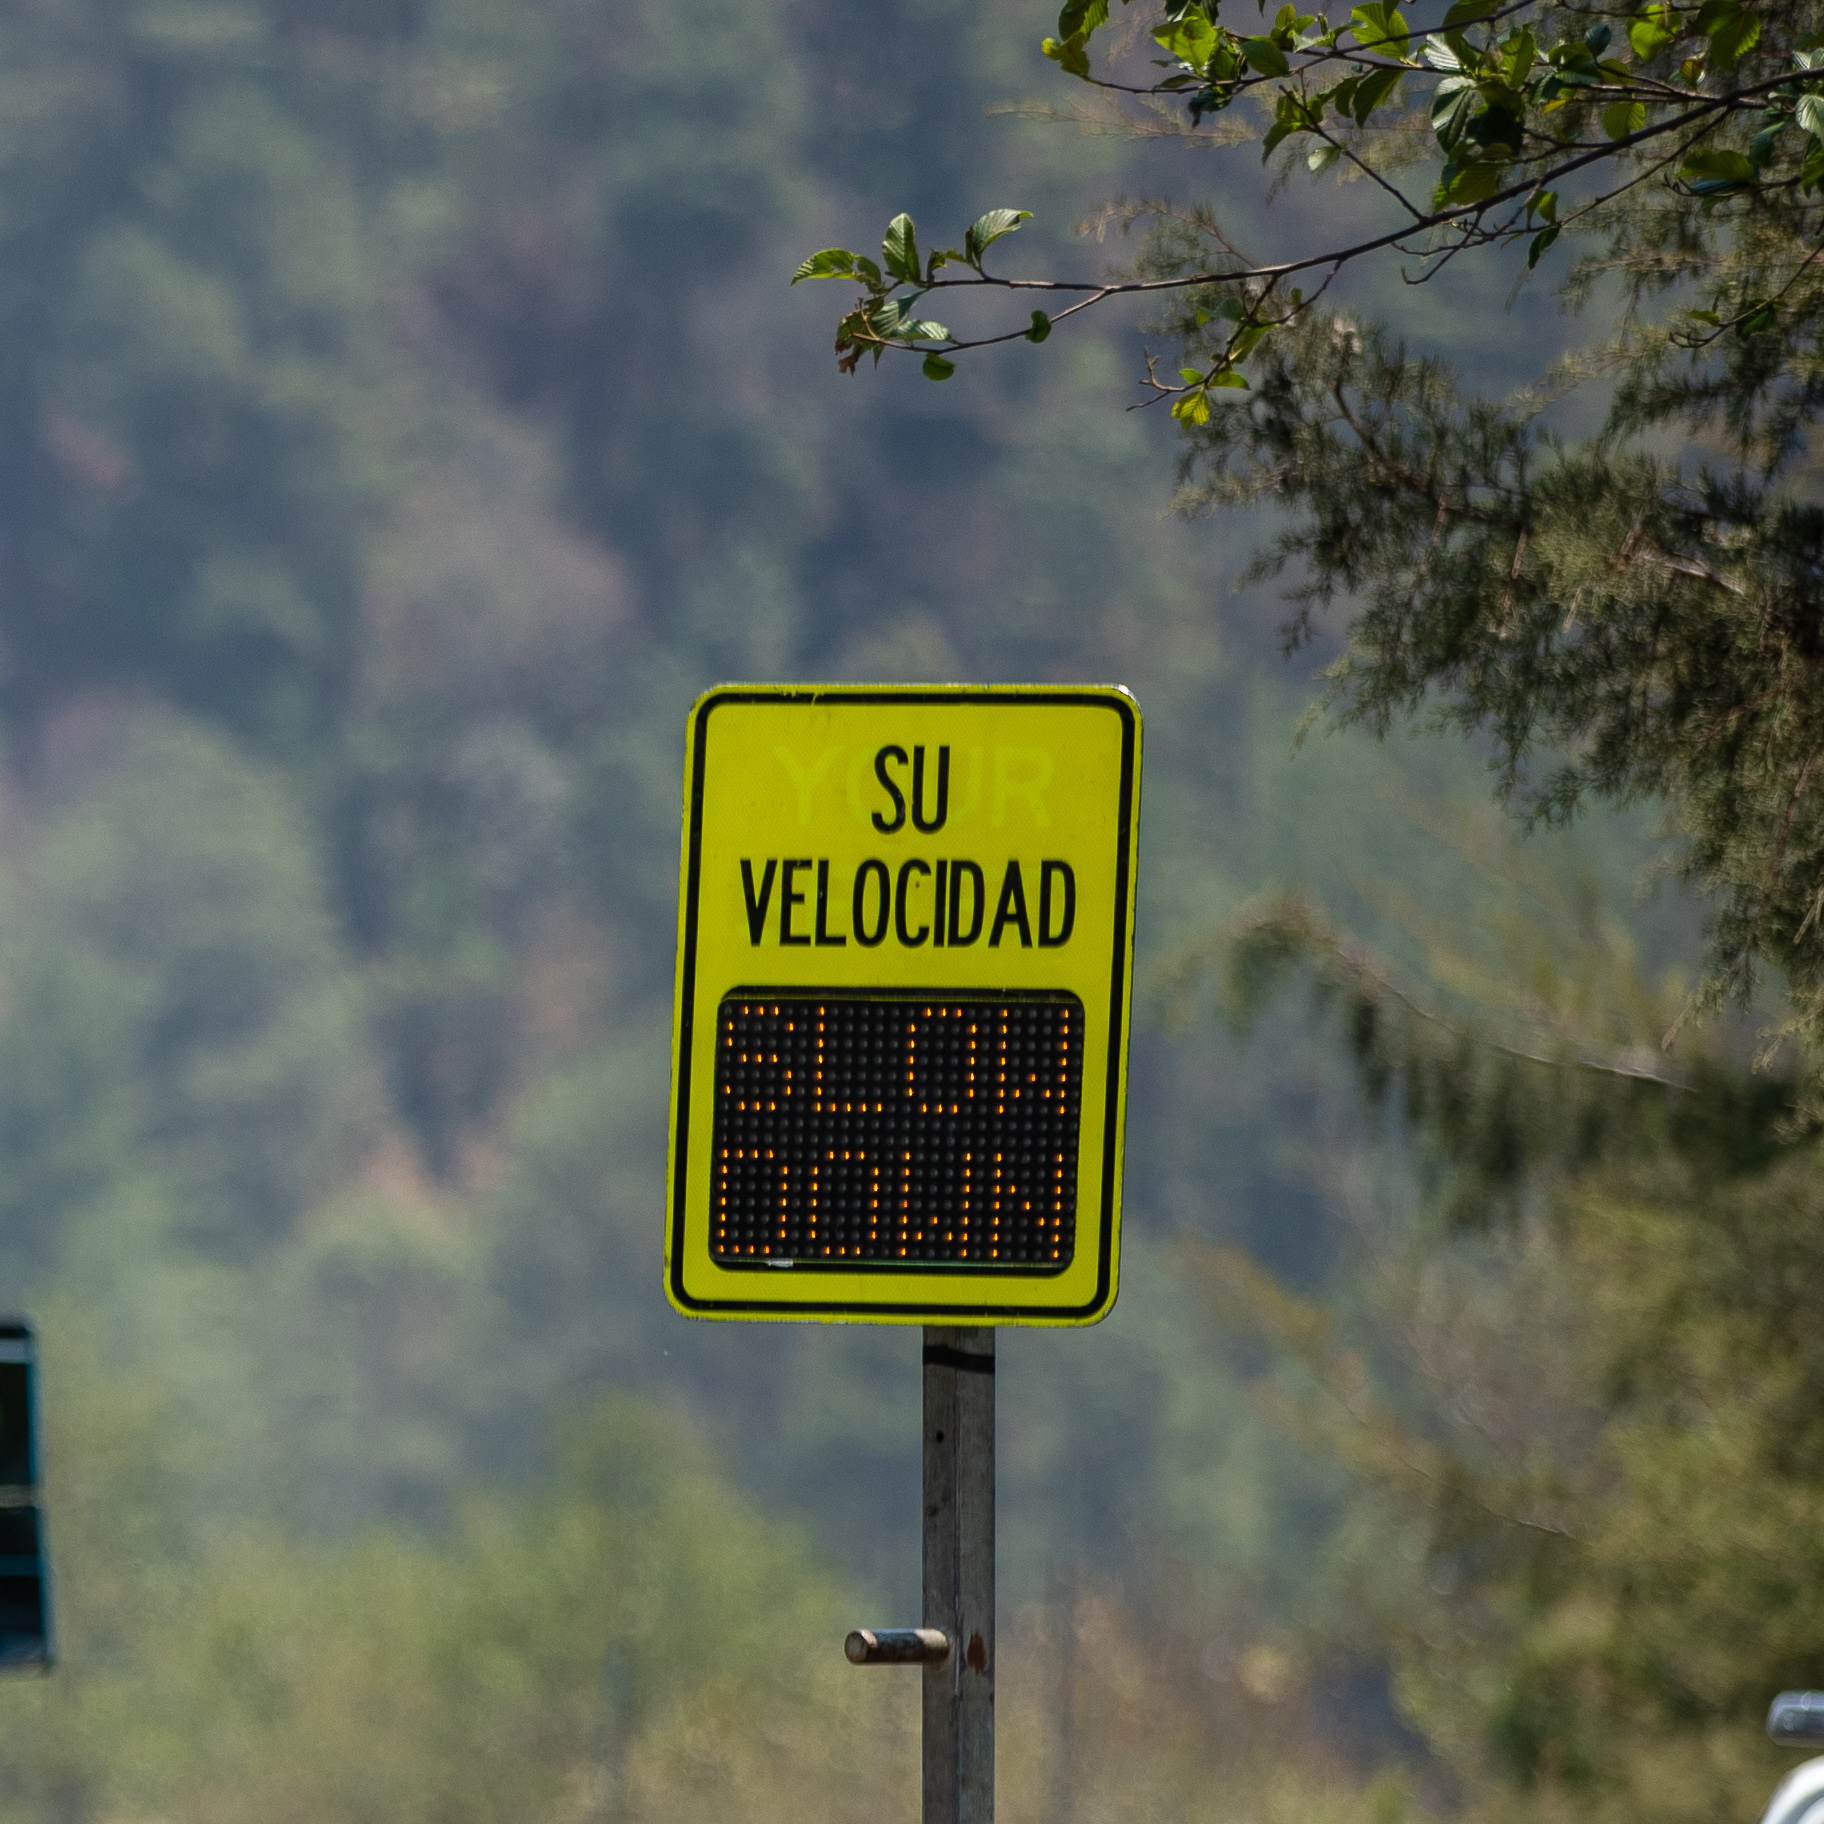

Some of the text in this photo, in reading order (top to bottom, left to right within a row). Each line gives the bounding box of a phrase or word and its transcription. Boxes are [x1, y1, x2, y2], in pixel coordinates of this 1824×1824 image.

[872, 745, 951, 834] SU
[739, 858, 1076, 949] VELOCIDAD
[725, 1005, 1070, 1114] SLOW
[717, 1149, 1064, 1259] DOWN
